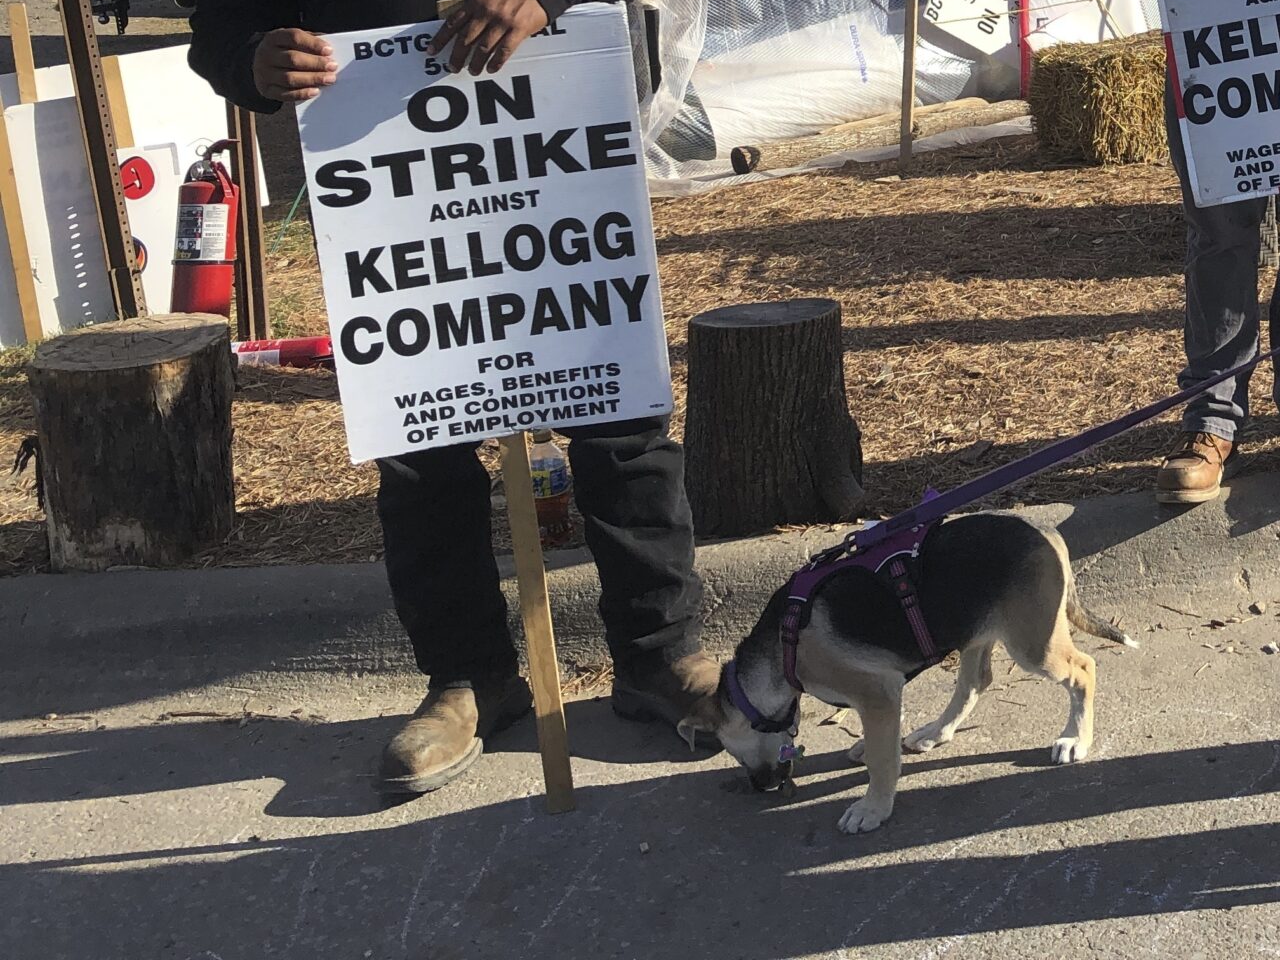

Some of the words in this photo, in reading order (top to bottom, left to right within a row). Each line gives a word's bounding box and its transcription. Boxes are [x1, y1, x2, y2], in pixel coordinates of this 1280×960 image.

[977, 8, 1000, 35] ON
[353, 33, 433, 61] BCTG
[407, 74, 535, 133] ON
[315, 121, 637, 208] STRIKE
[1233, 158, 1276, 178] AND
[1237, 175, 1265, 194] OF
[429, 189, 541, 223] AGAINST
[344, 211, 636, 298] KELLOGG
[340, 274, 650, 365] COMPANY
[394, 382, 494, 410] WAGES,
[502, 362, 620, 392] BENEFITS
[478, 351, 535, 374] FOR
[403, 404, 455, 427] AND
[464, 380, 620, 415] CONDITIONS
[406, 426, 441, 445] OF
[449, 398, 620, 437] EMPLOYMENT
